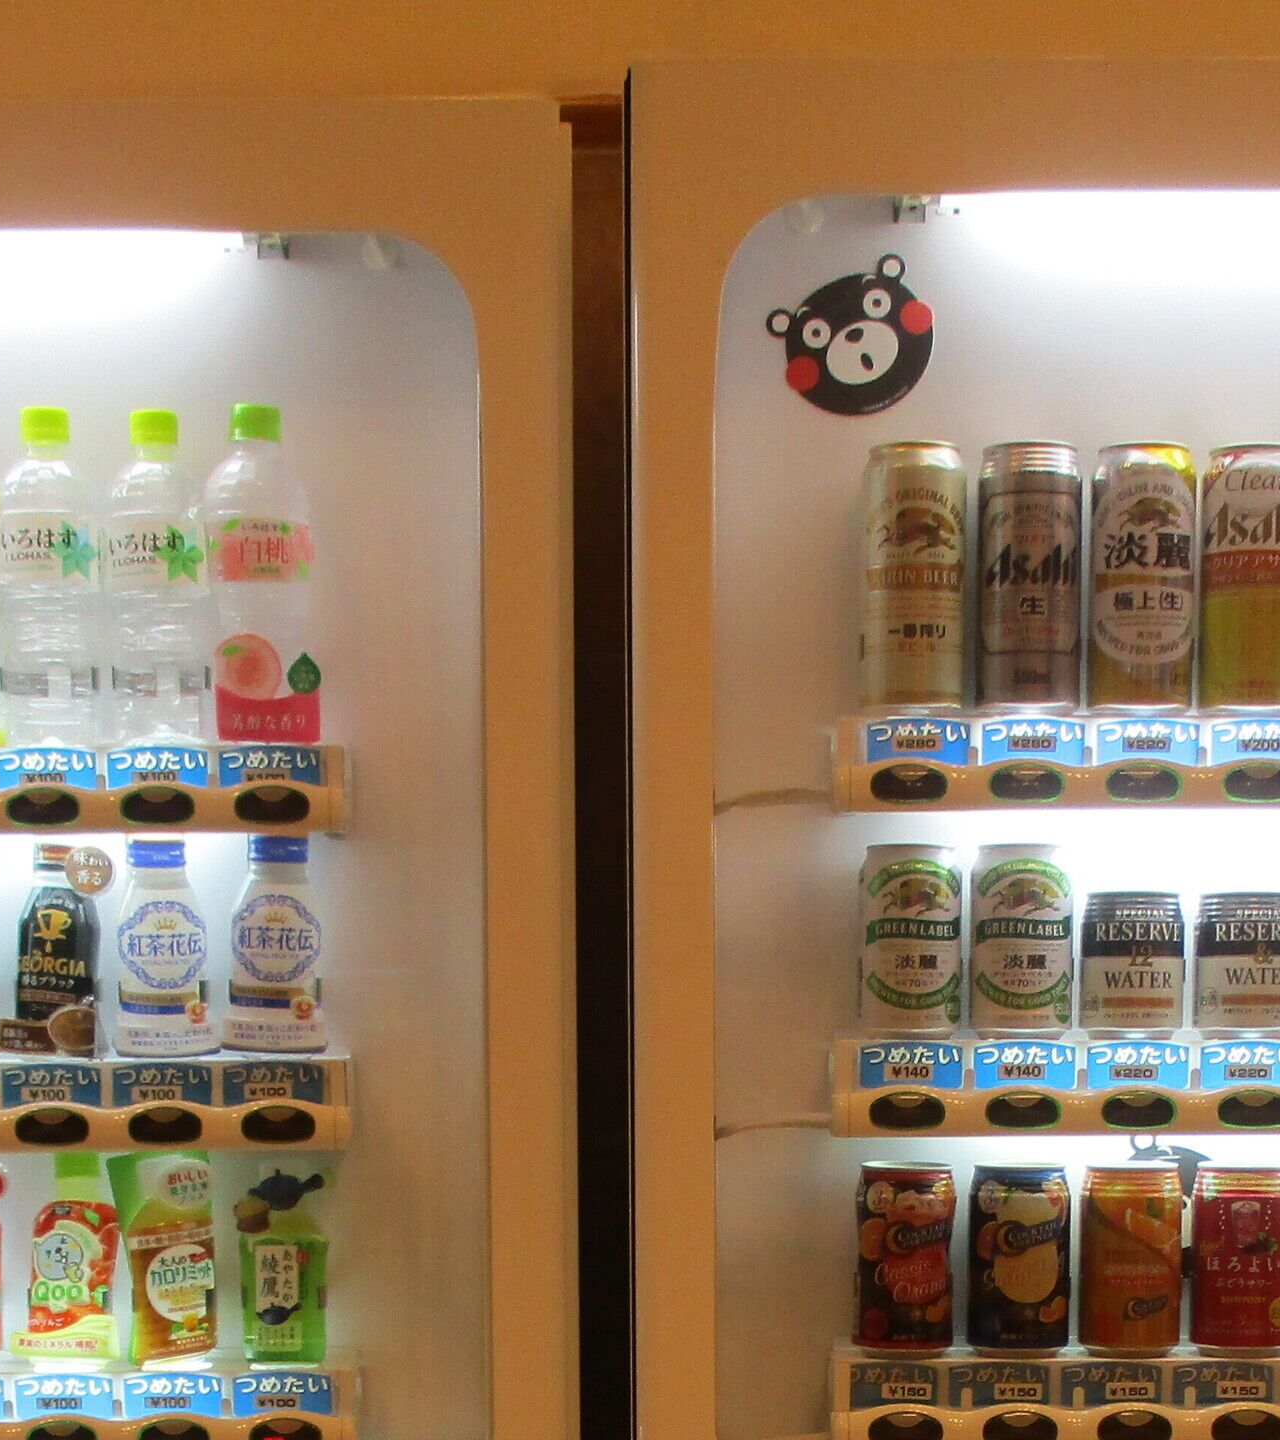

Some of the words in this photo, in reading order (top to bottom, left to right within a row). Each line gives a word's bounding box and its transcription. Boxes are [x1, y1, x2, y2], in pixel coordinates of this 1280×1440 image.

[1, 529, 78, 550] いろはす
[109, 531, 184, 555] いろはす
[238, 536, 290, 564] 白桃
[1104, 530, 1192, 570] 淡麗
[984, 543, 1078, 589] Asahi
[1020, 594, 1046, 616] 生
[887, 623, 947, 640] 一番搾り
[867, 722, 968, 744] つめたい
[983, 721, 1085, 743] つめたい
[1097, 721, 1199, 744] つめたい
[1126, 739, 1168, 750] ¥220
[1240, 739, 1280, 753] ¥200
[109, 751, 207, 771] つめたい
[222, 750, 318, 770] つめたい
[76, 869, 103, 886] 香る
[1115, 909, 1166, 921] SPECIAL
[875, 921, 918, 936] GREEN
[919, 922, 955, 937] LABEL
[984, 920, 1027, 936] GREEN
[1028, 921, 1065, 937] LABEL
[1096, 921, 1181, 942] RESERVE
[126, 932, 203, 958] 紅茶花伝
[238, 926, 314, 952] 紅茶花伝
[1103, 970, 1173, 990] WATER
[862, 1047, 960, 1067] つめたい
[975, 1046, 1074, 1066] つめたい
[1088, 1046, 1188, 1066] つめたい
[4, 1068, 100, 1087] つめたい
[114, 1067, 209, 1086] つめたい
[224, 1067, 320, 1087] つめたい
[891, 1065, 929, 1079] ¥140
[1004, 1065, 1041, 1079] ¥140
[1112, 1067, 1154, 1079] ¥220
[1227, 1067, 1268, 1079] ¥220
[29, 1088, 66, 1102] ¥100
[139, 1088, 177, 1102] ¥100
[247, 1086, 288, 1098] ¥100
[1206, 1256, 1280, 1273] ほろよい
[260, 1254, 280, 1298] 綾鷹
[34, 1280, 83, 1302] Qoo
[851, 1366, 935, 1385] つめたい
[950, 1365, 1049, 1384] つめたい
[1061, 1365, 1160, 1383] つめたい
[1175, 1365, 1274, 1383] つめたい
[16, 1379, 110, 1397] つめたい
[126, 1378, 220, 1396] つめたい
[235, 1376, 329, 1395] つめたい
[889, 1386, 928, 1398] ¥150
[997, 1386, 1038, 1398] ¥150
[1109, 1386, 1149, 1398] ¥150
[1220, 1384, 1260, 1397] ¥150
[41, 1398, 78, 1410] ¥100
[151, 1397, 188, 1409] ¥100
[257, 1398, 296, 1409] ¥100
